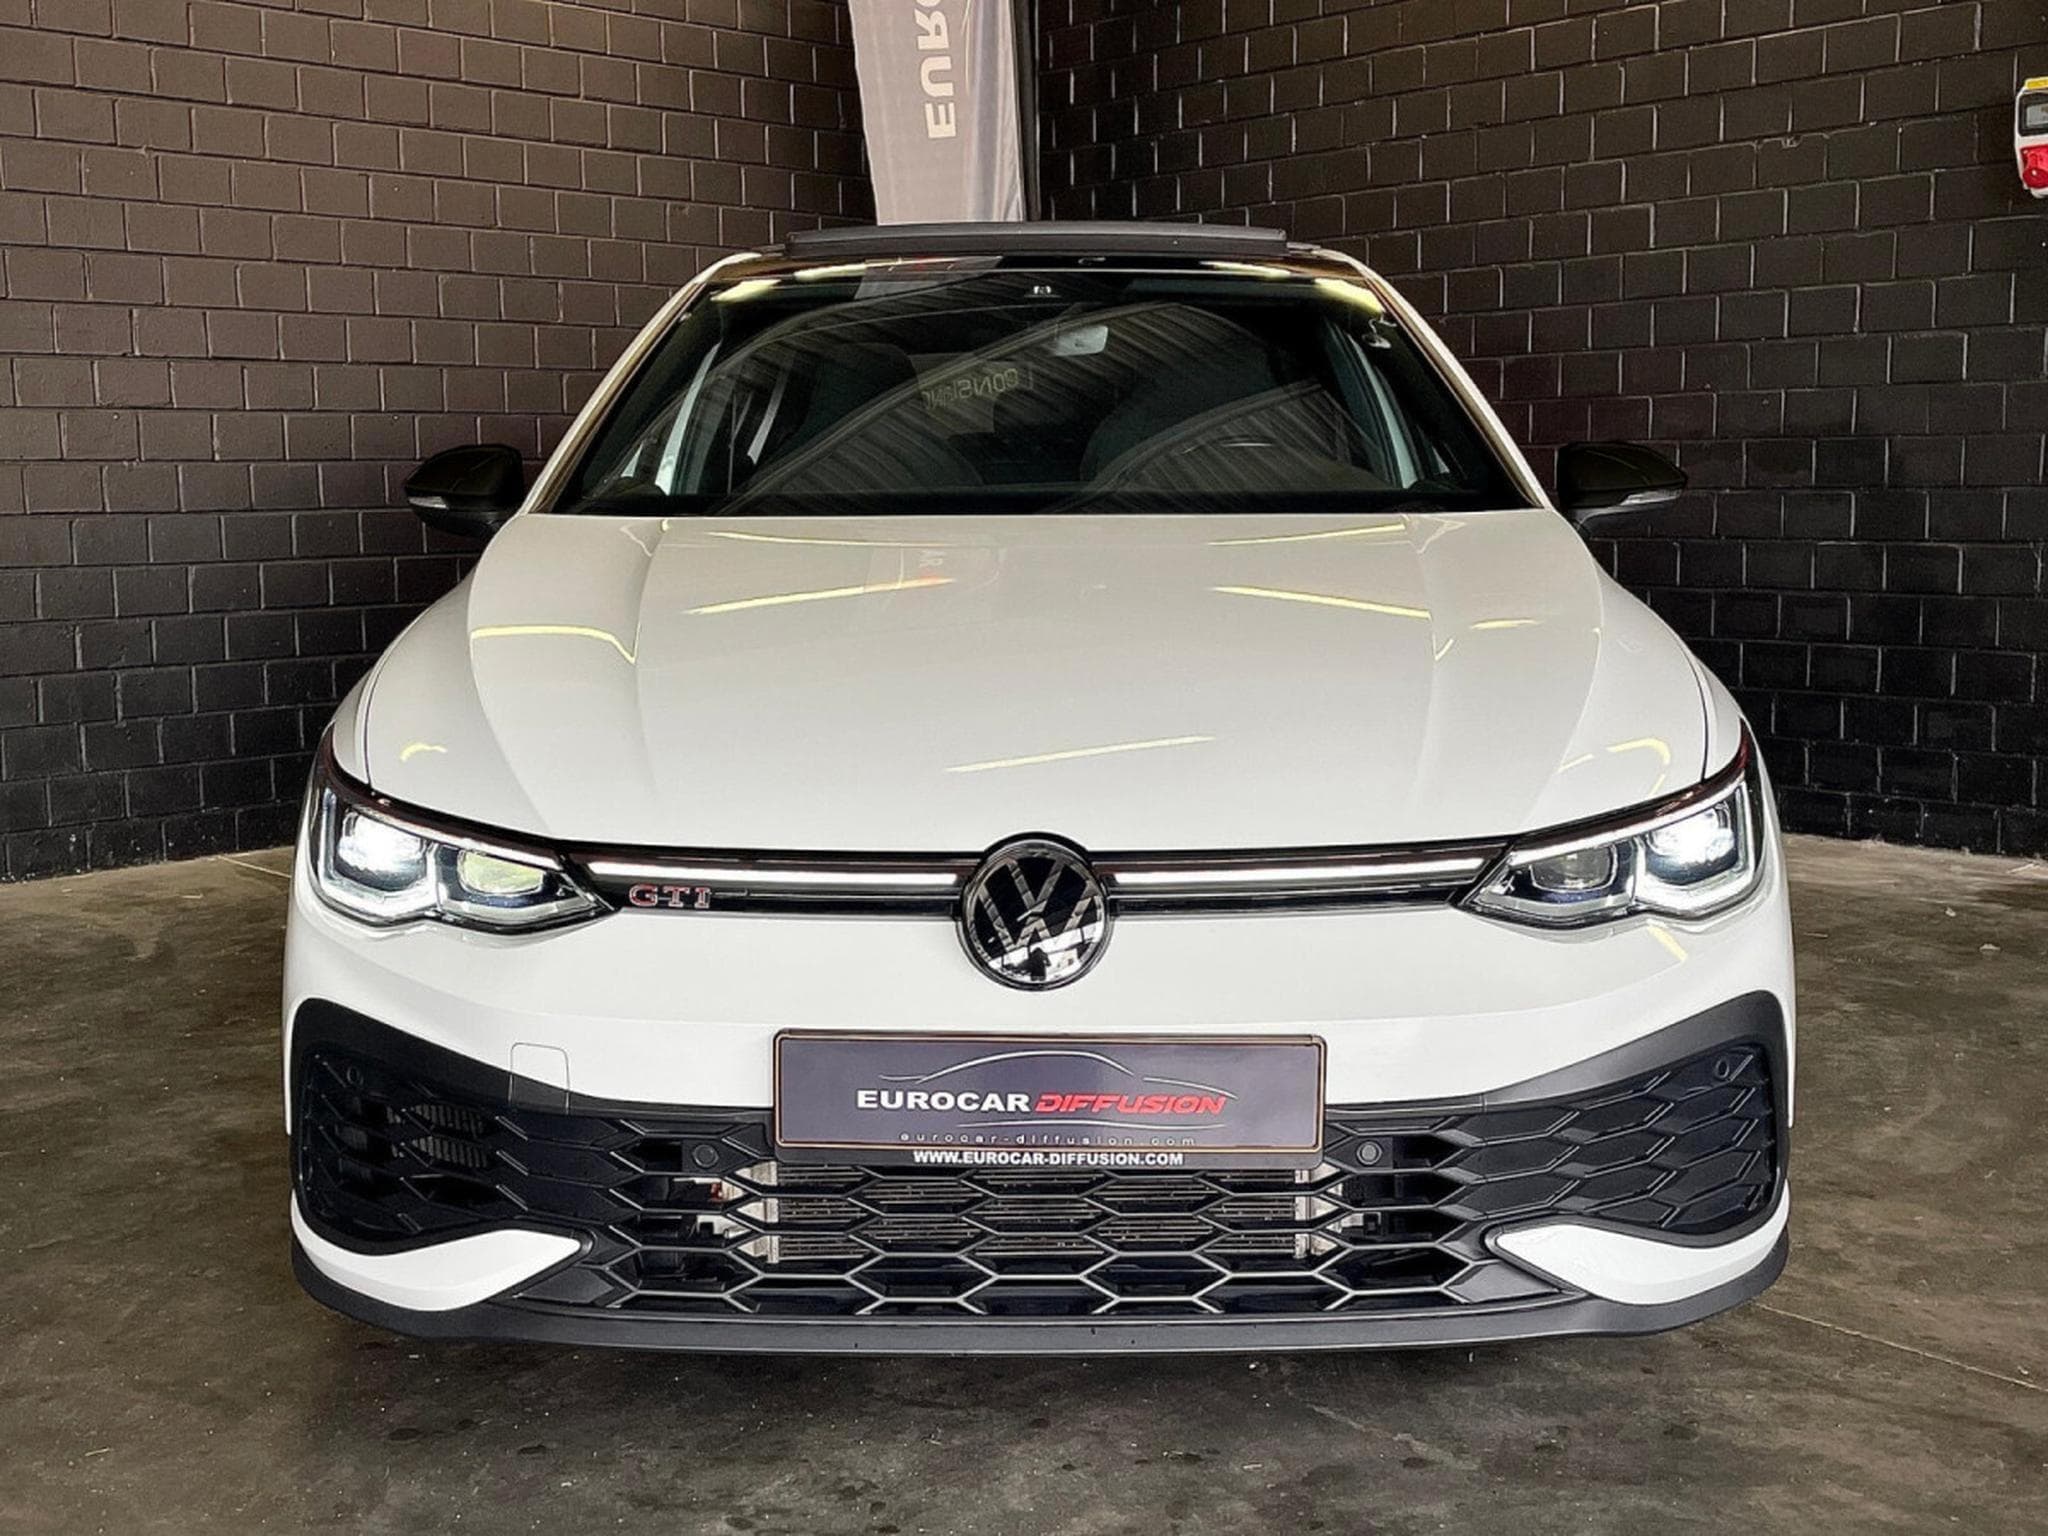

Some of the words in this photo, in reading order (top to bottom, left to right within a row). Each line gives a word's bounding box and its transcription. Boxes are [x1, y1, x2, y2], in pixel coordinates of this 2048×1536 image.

[914, 0, 956, 139] EUR
[629, 884, 711, 909] GTI
[857, 1089, 1031, 1113] EUROCAR
[1035, 1093, 1227, 1114] DIFFUSION
[900, 1133, 1196, 1146] eurocar-diffusion.com
[913, 1150, 1184, 1166] WWW.EUROCAR-DIFFUSION.COM
